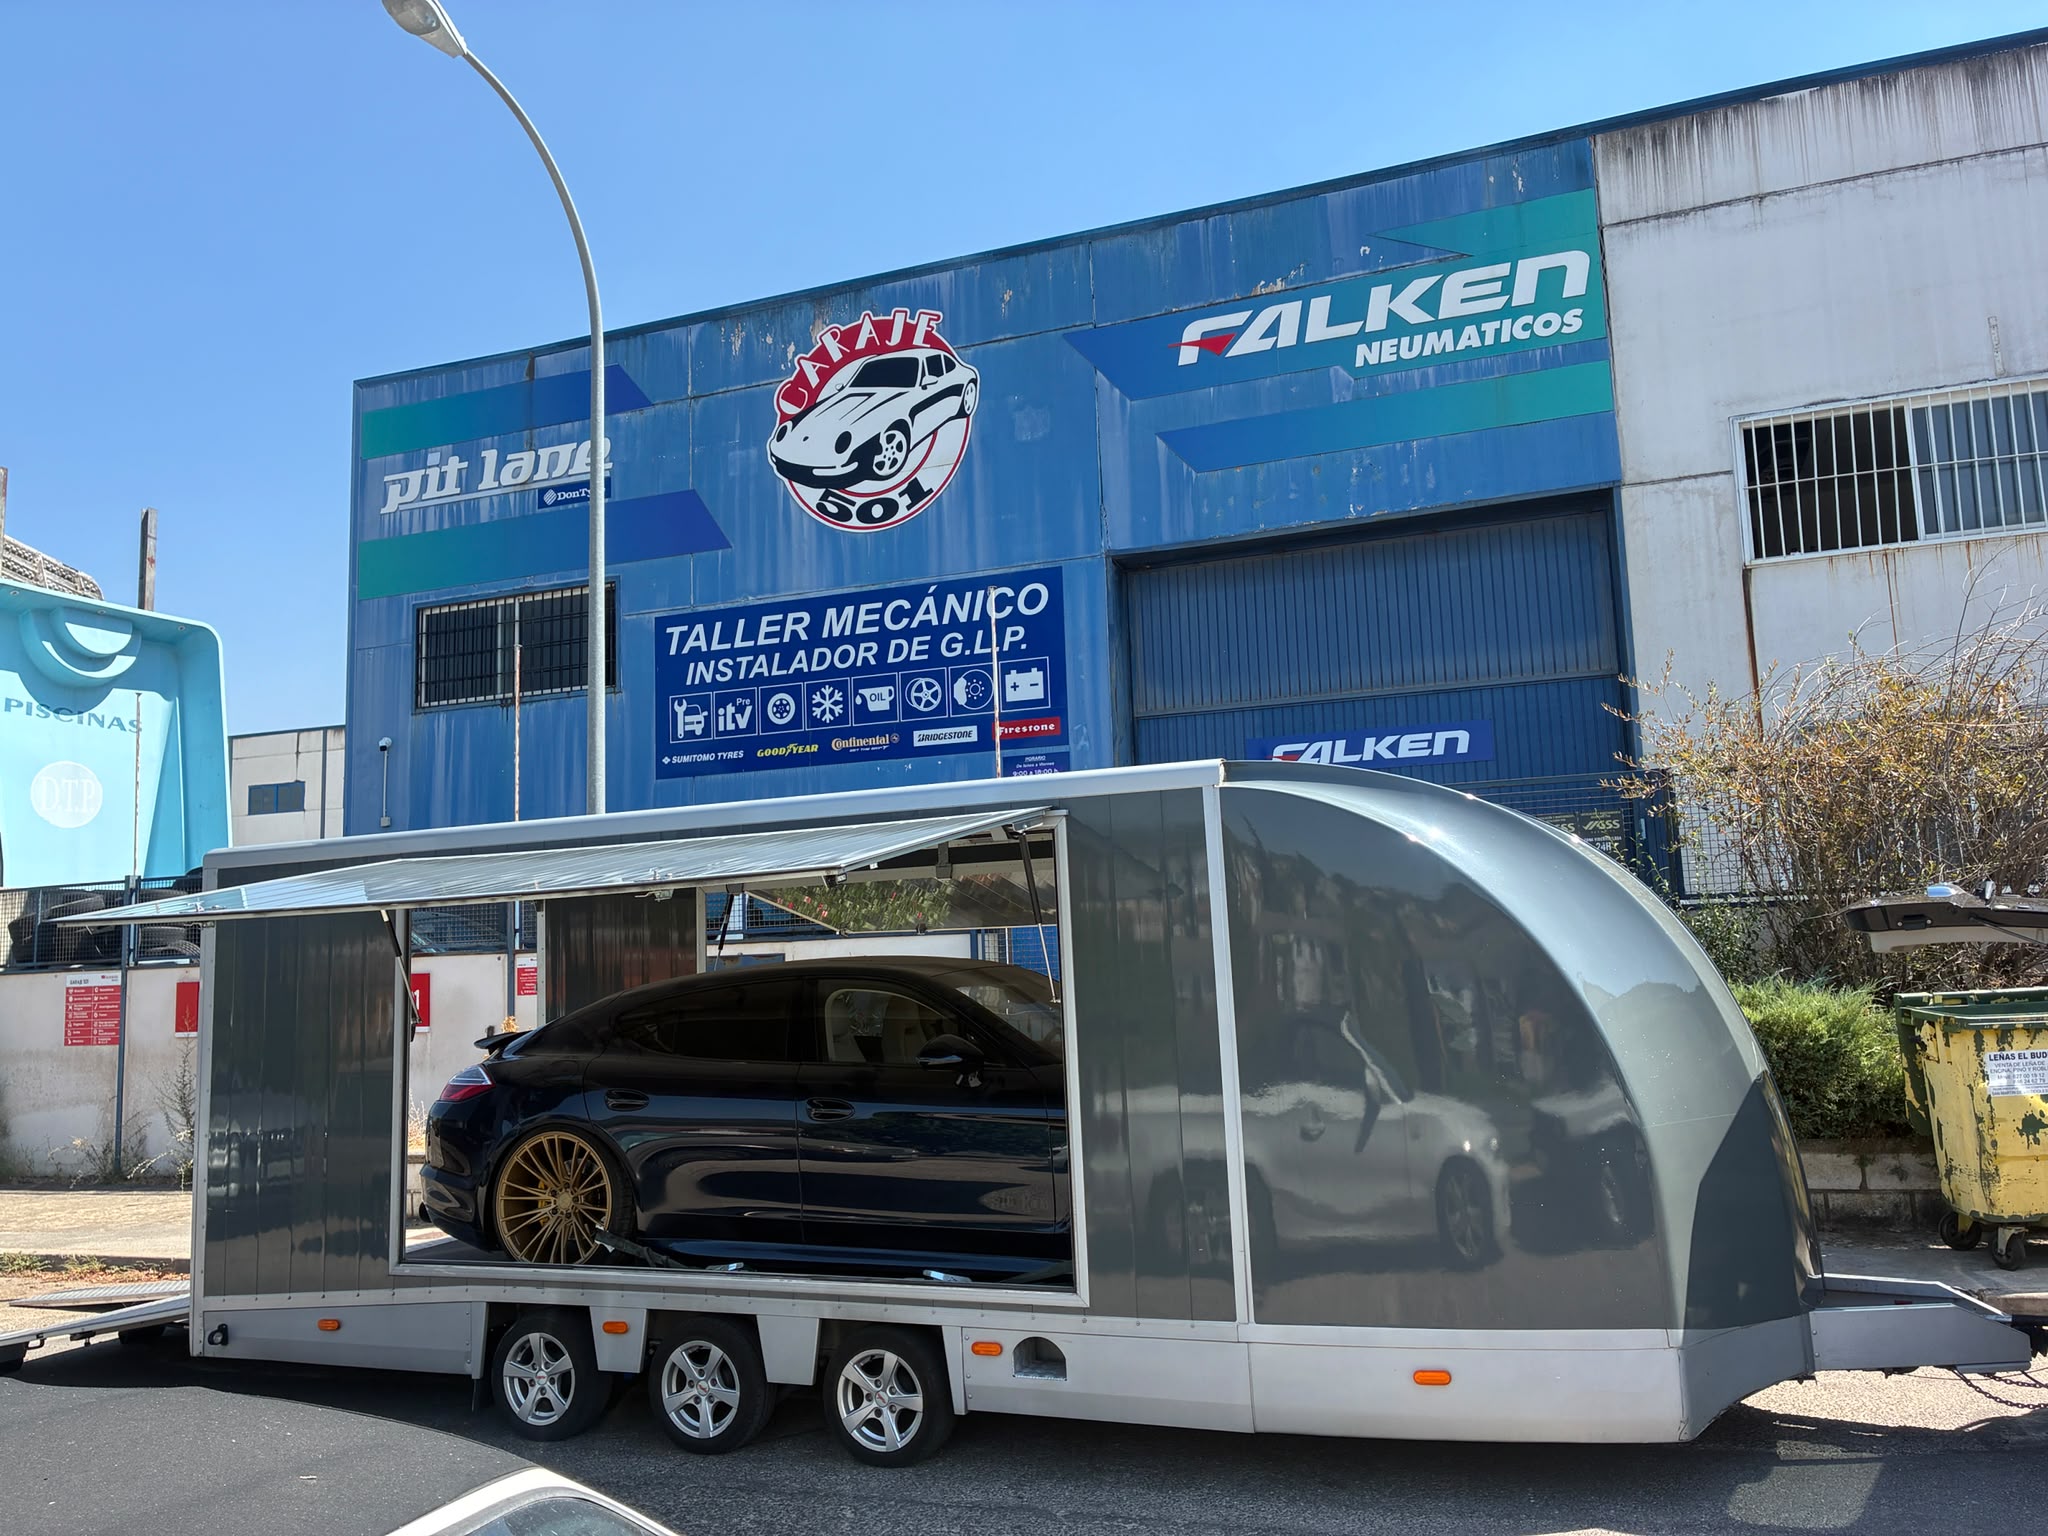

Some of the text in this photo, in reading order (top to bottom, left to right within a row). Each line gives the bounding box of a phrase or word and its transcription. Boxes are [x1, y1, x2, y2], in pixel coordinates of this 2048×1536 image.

[1177, 250, 1591, 367] FALKEN
[1354, 308, 1584, 368] NEUMATICOS
[777, 311, 942, 415] GARAJE
[380, 437, 613, 514] pit lane
[557, 487, 605, 501] DonTy
[815, 477, 934, 524] 501
[666, 583, 1049, 655] TALLER MECÁNICO
[686, 625, 1027, 685] INSTALADOR DE G.L.P.
[736, 697, 750, 707] Pre
[869, 692, 886, 702] OIL
[4, 697, 143, 734] PISCINAS
[718, 703, 752, 732] itv
[999, 723, 1056, 736] Firestone
[756, 743, 819, 757] GOODYEAR
[831, 733, 890, 751] Continental
[917, 730, 973, 743] BRIDGESTONE
[1272, 729, 1470, 764] FALKEN
[672, 750, 744, 764] SUMITOMO TYRES
[1989, 1051, 2015, 1062] LEÑAS
[2018, 1052, 2028, 1060] EL
